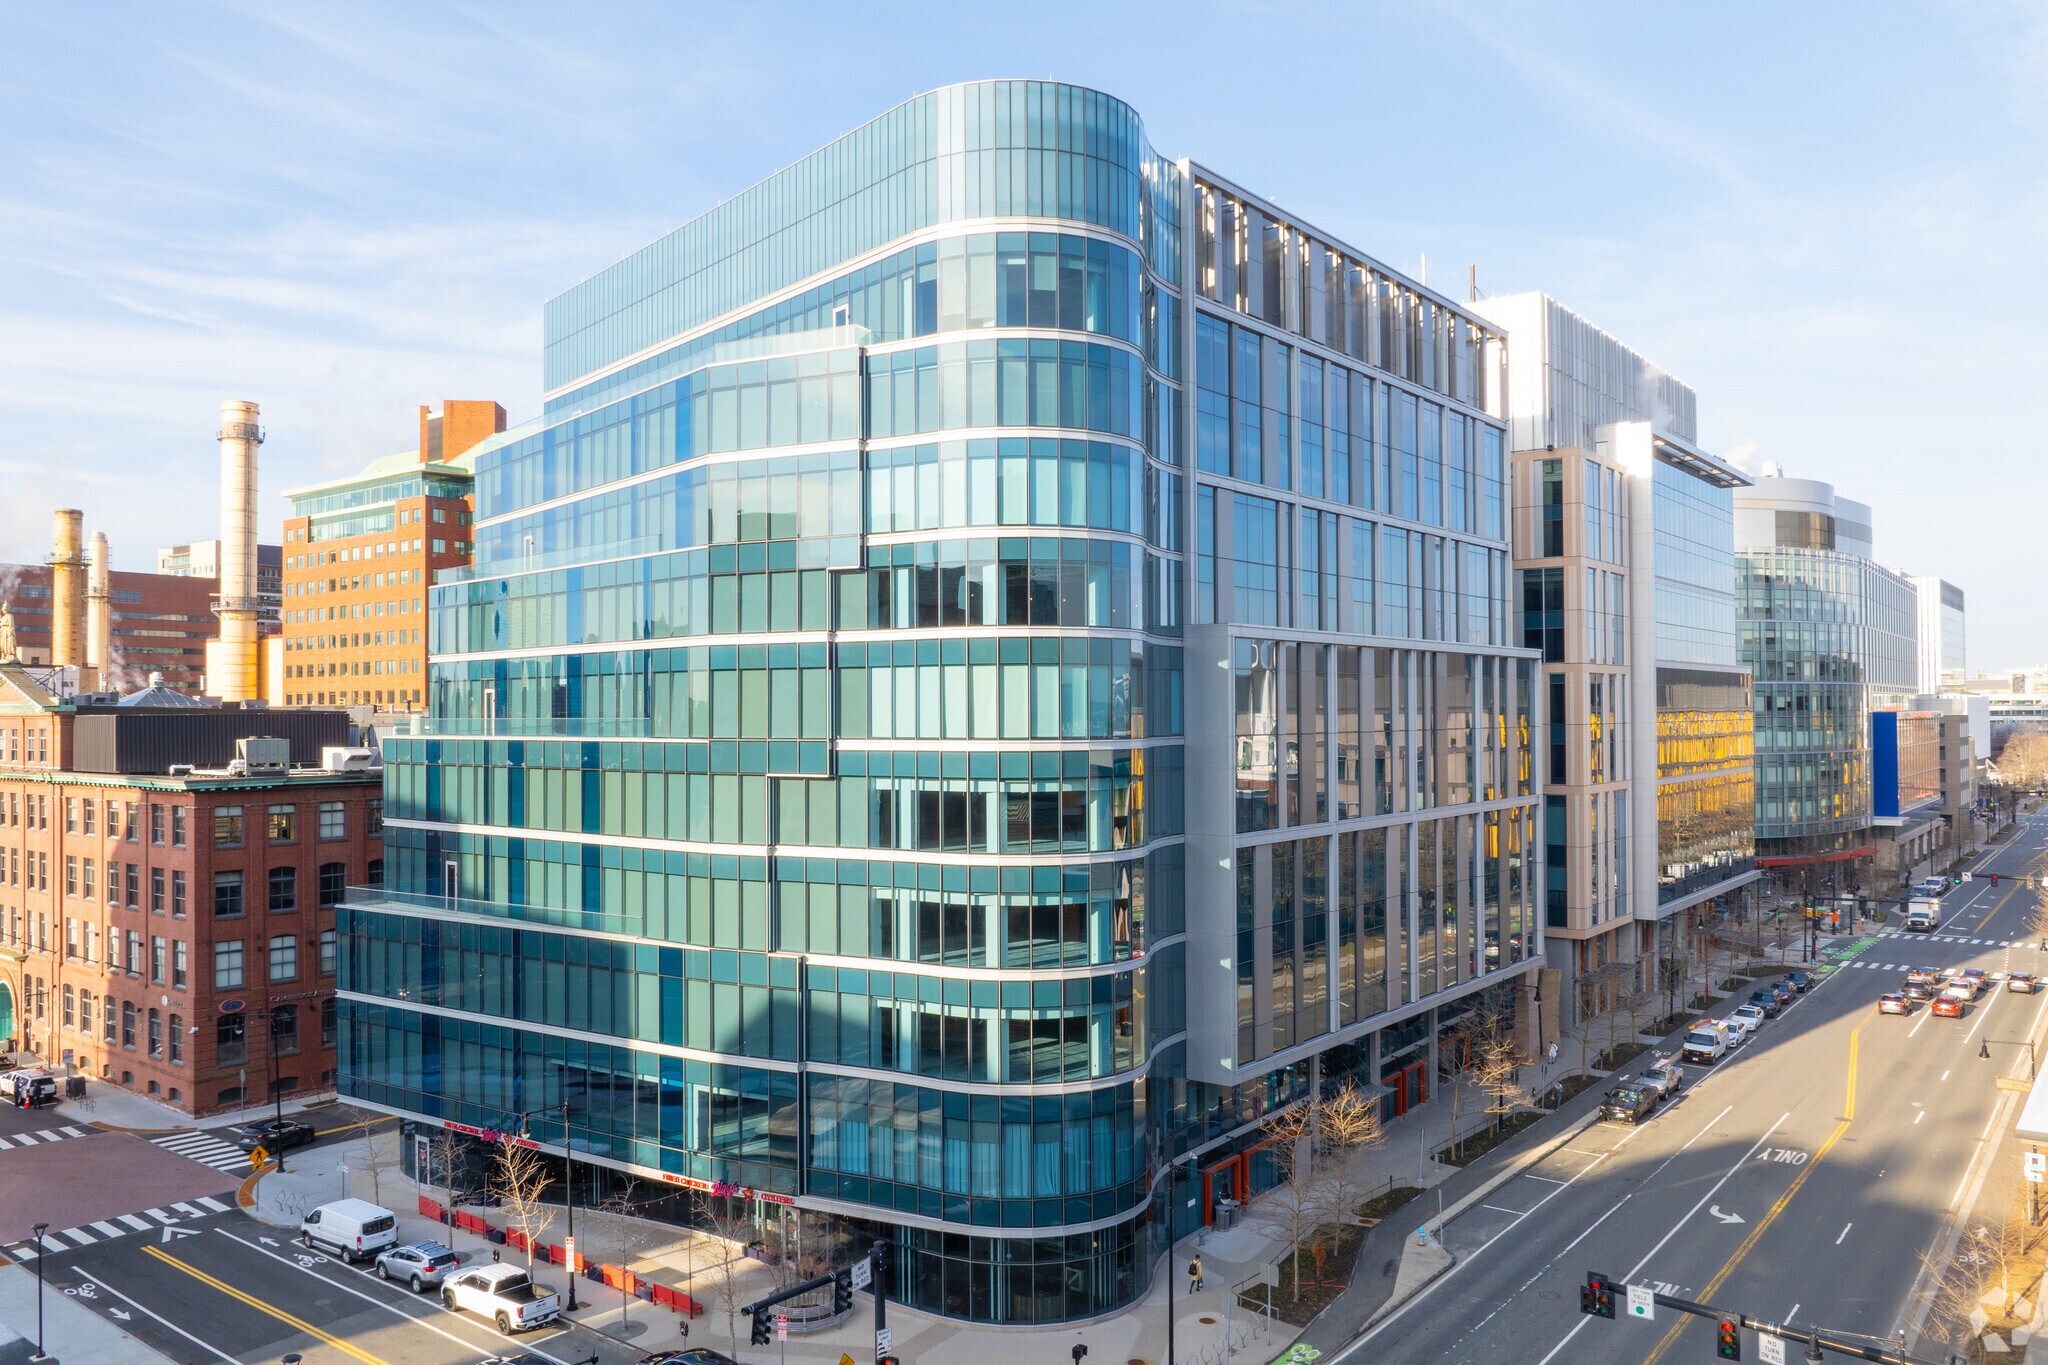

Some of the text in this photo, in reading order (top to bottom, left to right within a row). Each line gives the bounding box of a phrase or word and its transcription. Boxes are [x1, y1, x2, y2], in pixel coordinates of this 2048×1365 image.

[1756, 1147, 1808, 1166] ONLY
[662, 1173, 706, 1189] FRIED CHICKEN
[760, 1193, 794, 1205] OYSTERS
[857, 1264, 865, 1272] NO
[855, 1270, 867, 1280] TURN
[860, 1275, 870, 1285] RED
[1767, 1339, 1777, 1348] NO
[1764, 1345, 1780, 1356] TURN
[1761, 1351, 1783, 1364] ON RED
